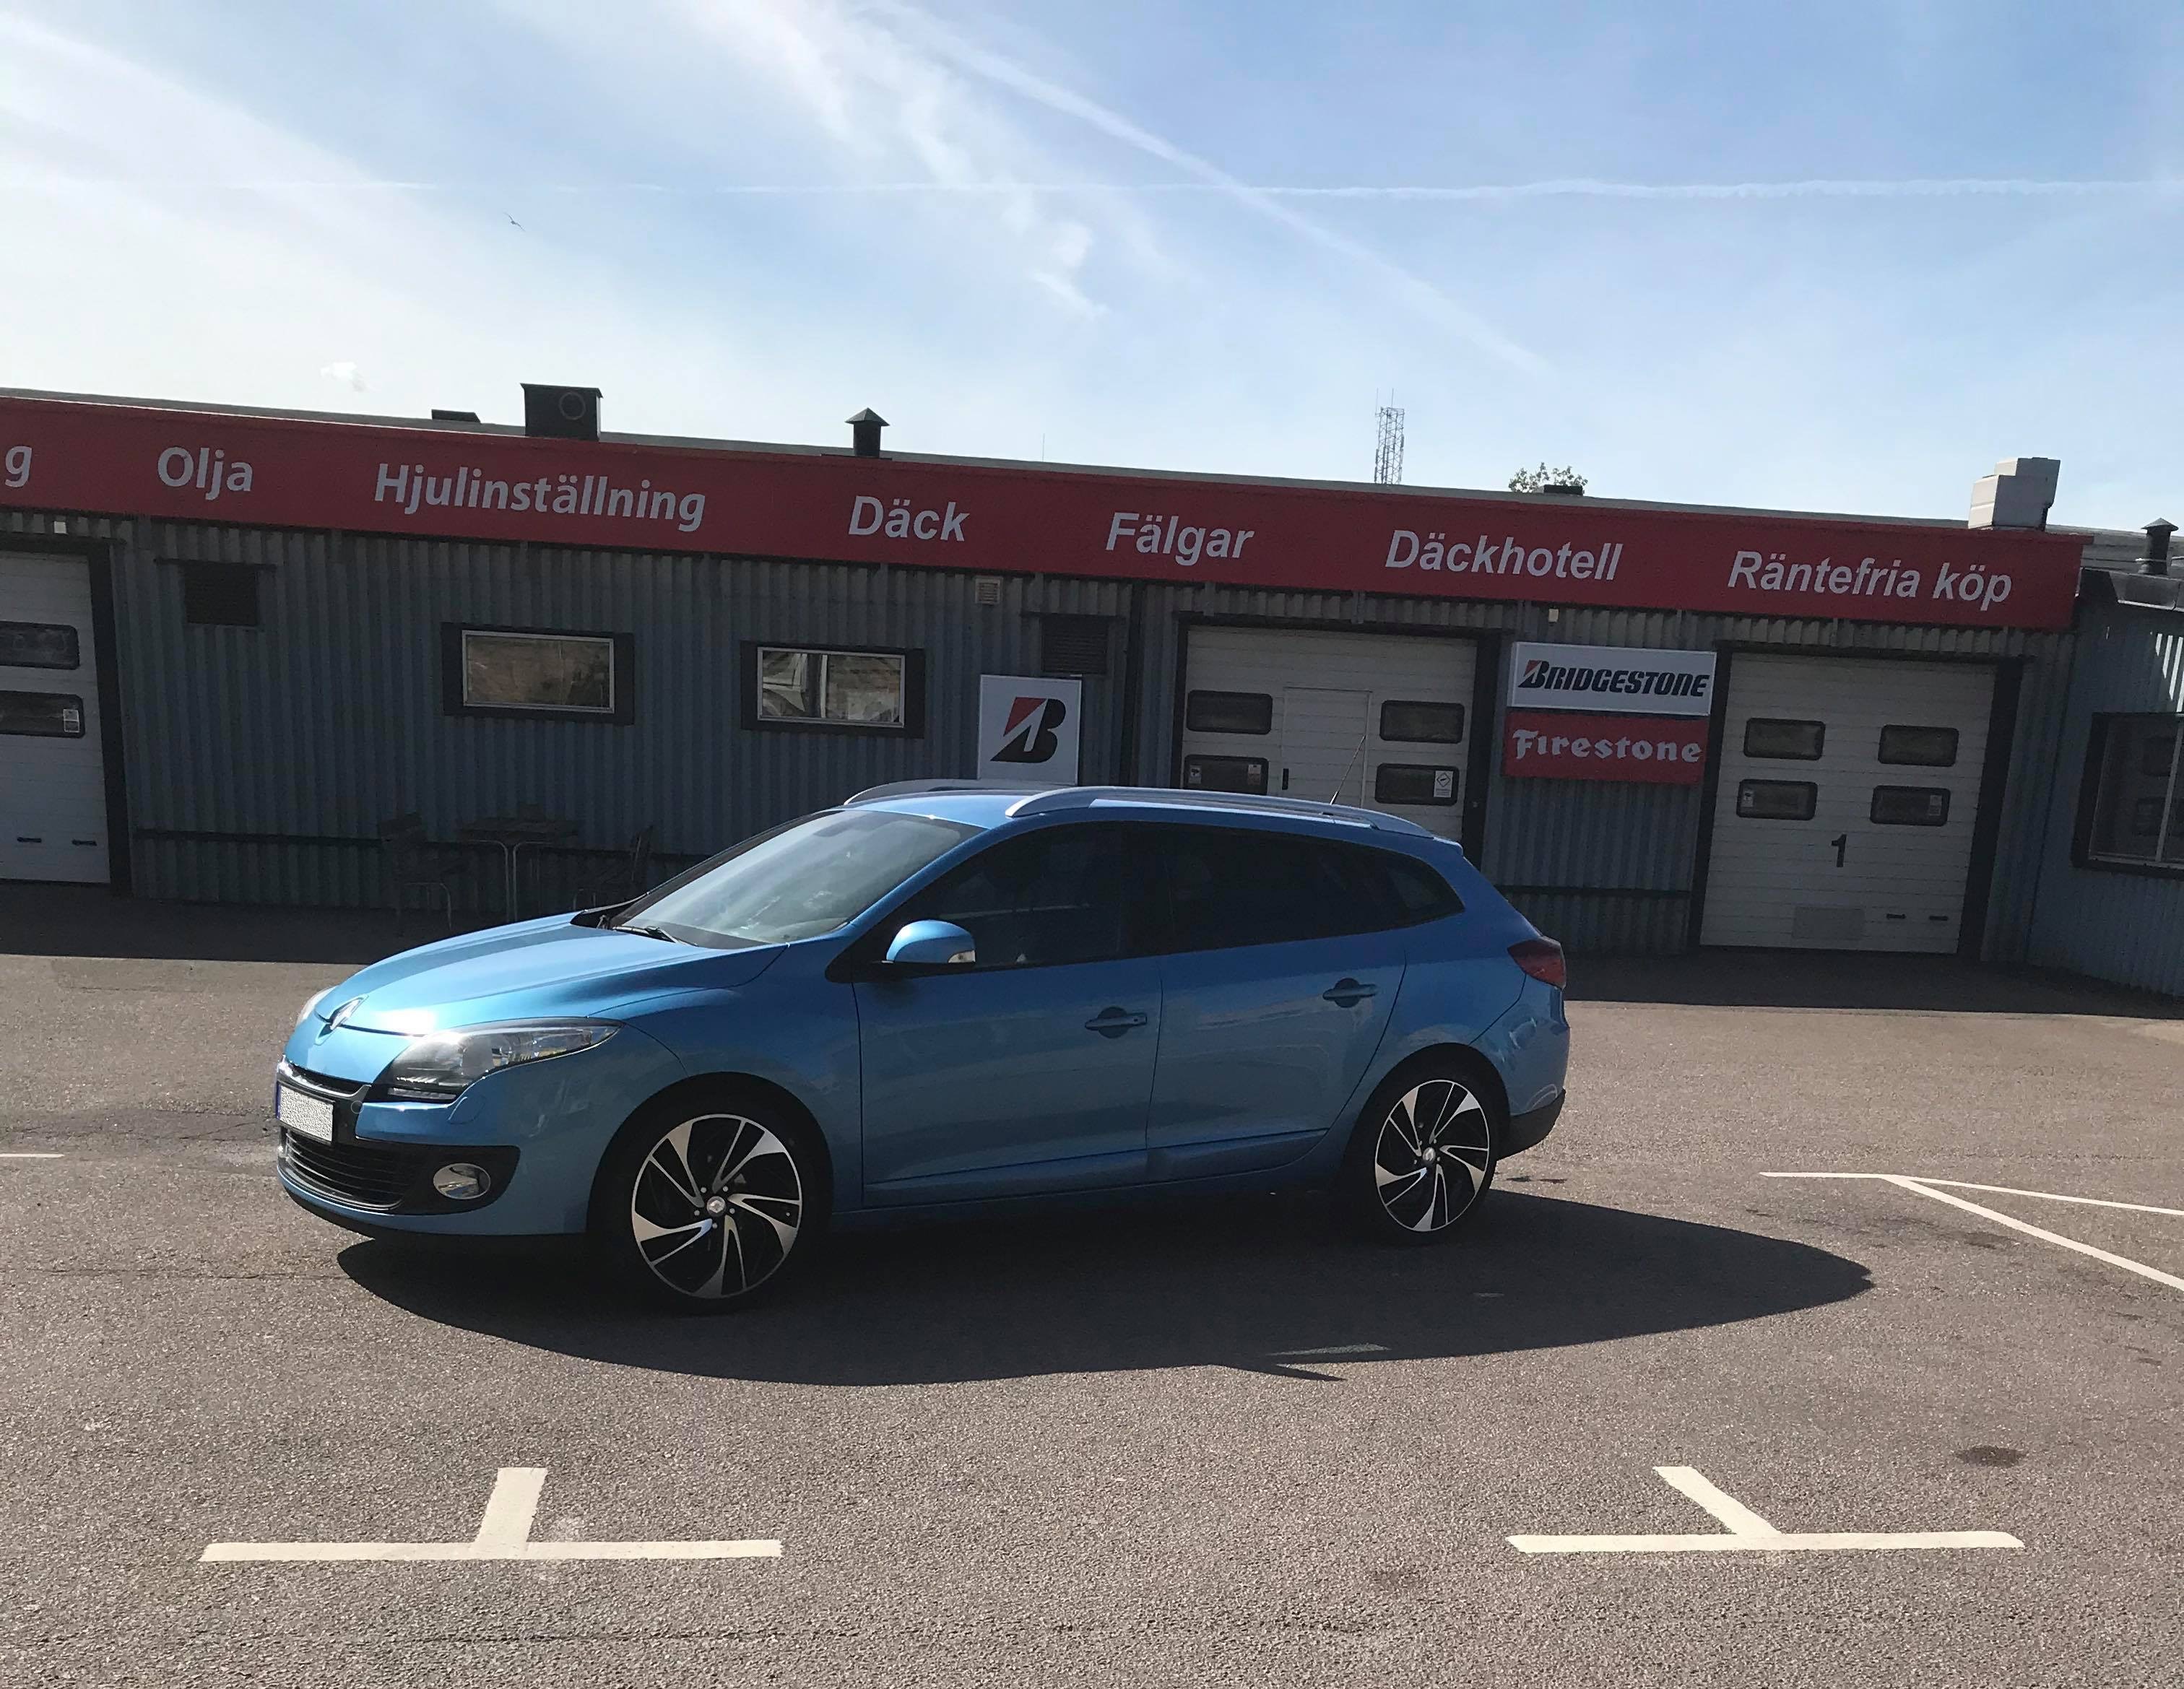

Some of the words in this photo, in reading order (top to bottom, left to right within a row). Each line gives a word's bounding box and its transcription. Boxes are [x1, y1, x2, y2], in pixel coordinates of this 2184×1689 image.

[157, 447, 253, 500] Olja
[375, 463, 706, 532] Hjulinställning
[849, 495, 970, 542] Däck
[1106, 512, 1254, 566] Fälgar
[1385, 529, 1624, 581] Däckhotell
[1728, 550, 1920, 599] Räntefria
[1932, 563, 2012, 612] köp
[1518, 659, 1710, 697] BRIDGESTONE
[1512, 729, 1702, 763] Firestone
[1831, 833, 1847, 868] 1
